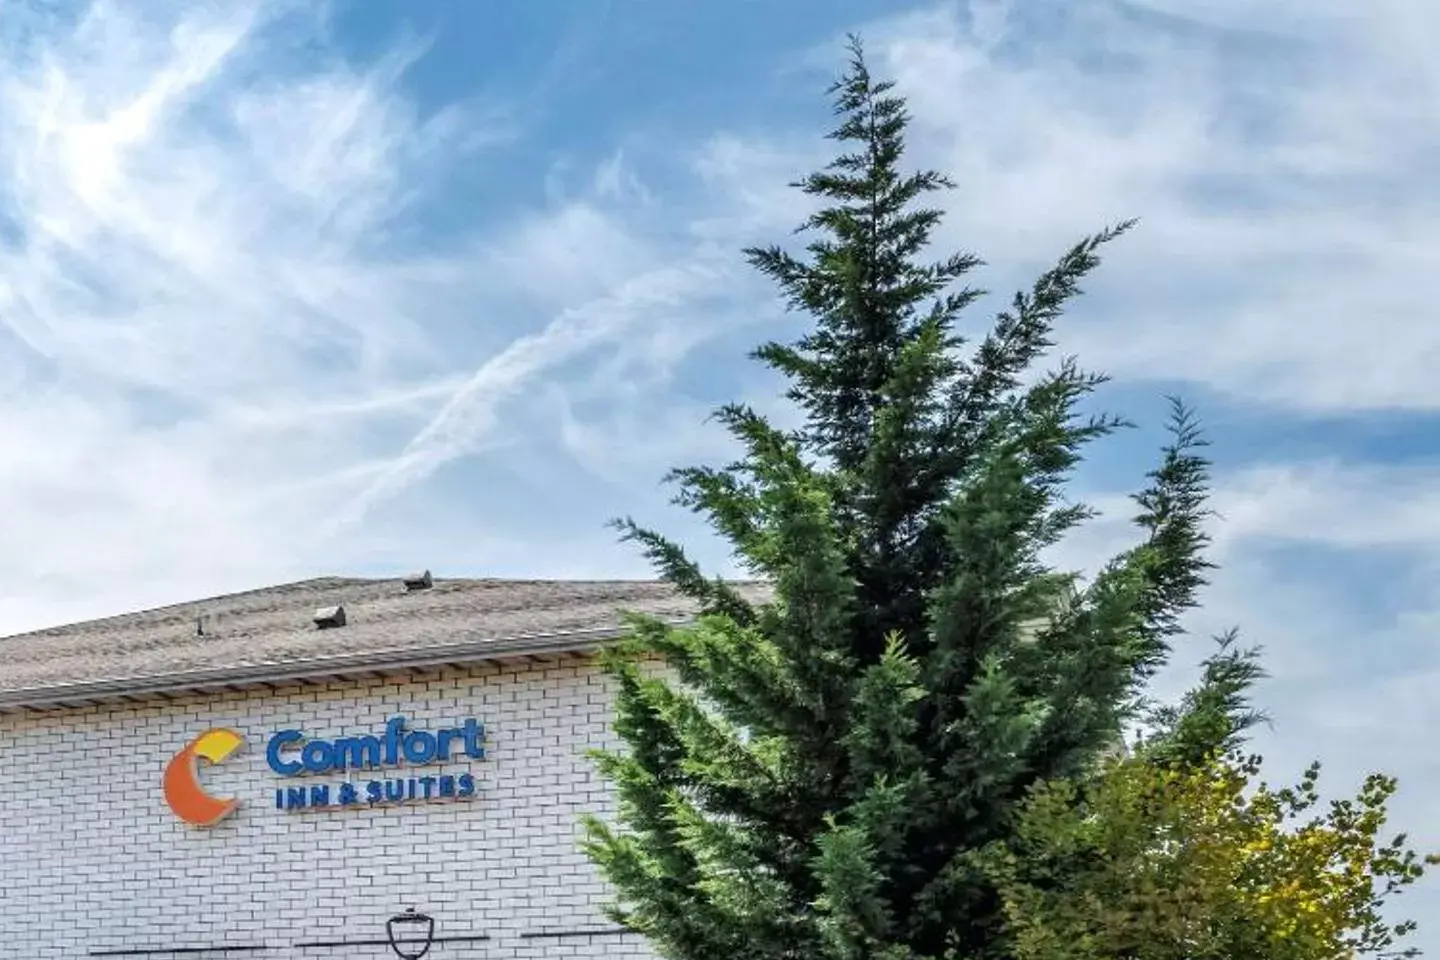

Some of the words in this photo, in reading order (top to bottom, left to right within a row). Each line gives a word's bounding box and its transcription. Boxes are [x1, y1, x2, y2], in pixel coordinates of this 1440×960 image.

[266, 716, 485, 776] Comfort
[275, 785, 330, 810] INN
[336, 782, 360, 806] &
[365, 773, 476, 803] SUITES
